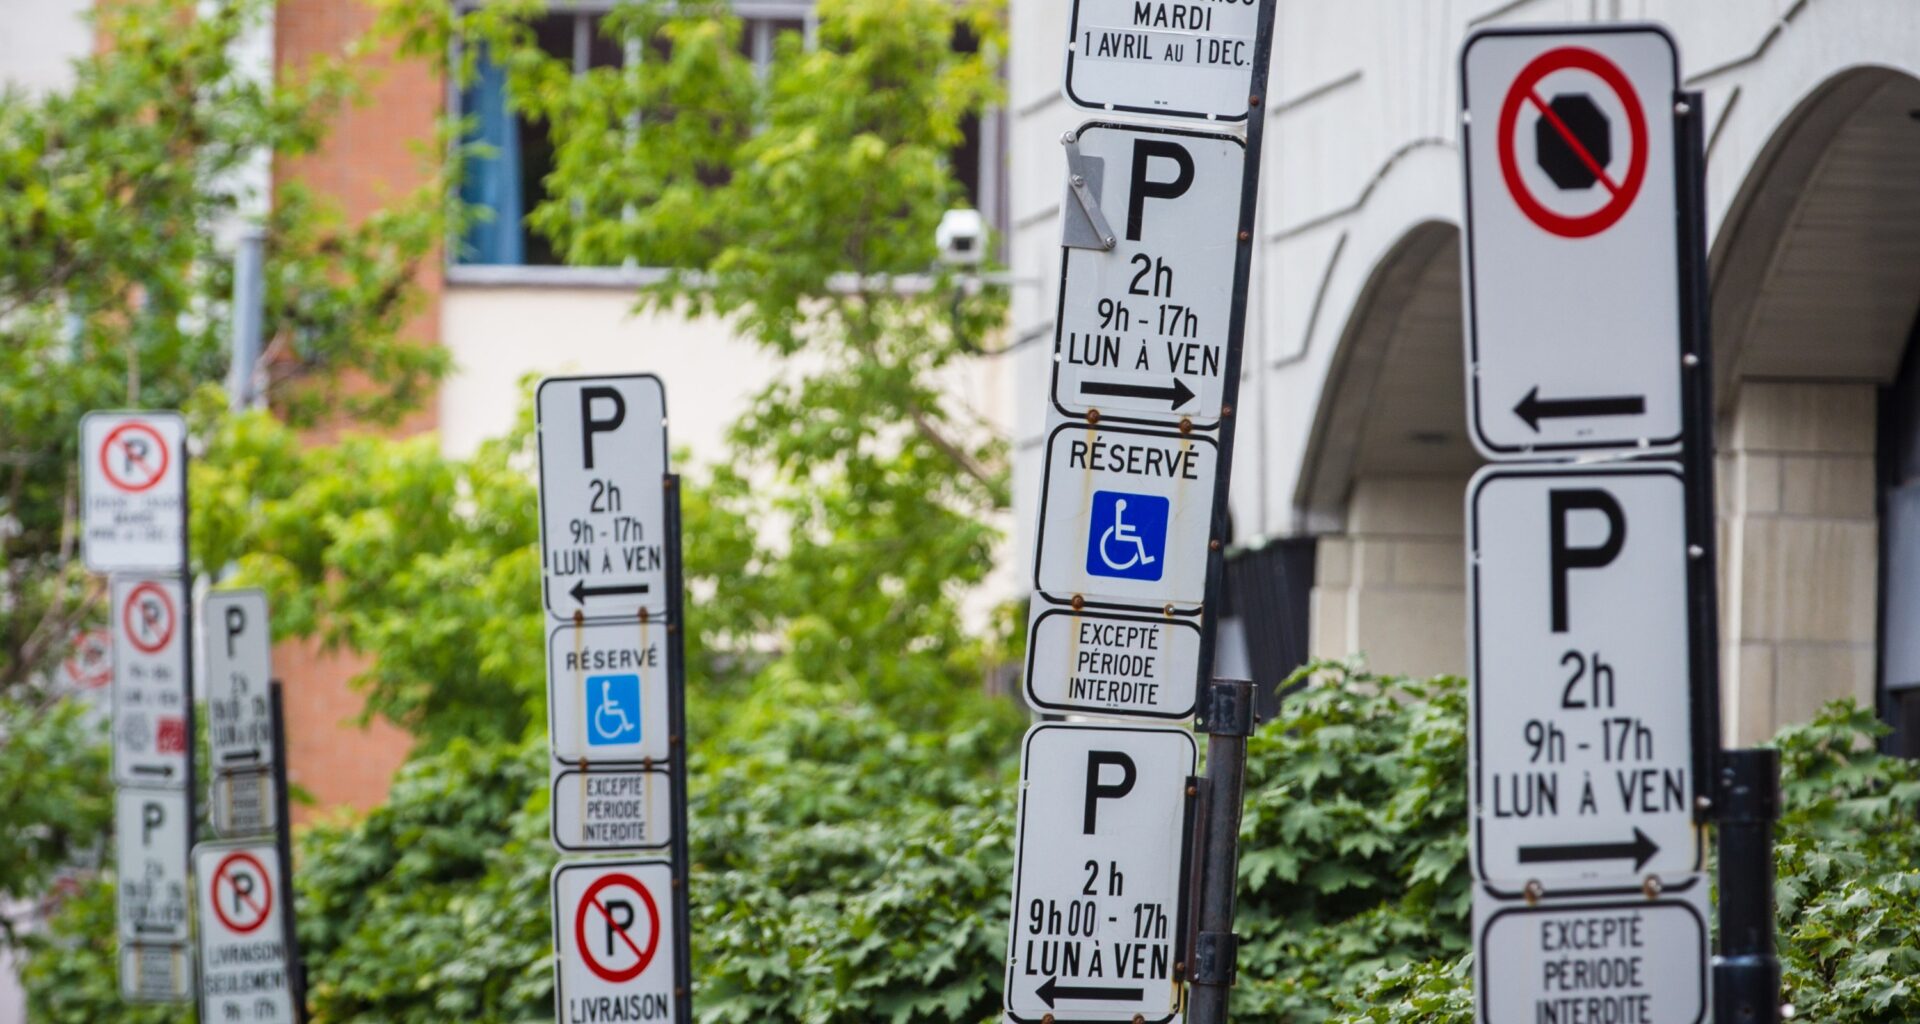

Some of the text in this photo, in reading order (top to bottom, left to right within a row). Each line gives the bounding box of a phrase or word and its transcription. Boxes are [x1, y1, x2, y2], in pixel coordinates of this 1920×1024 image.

[1134, 1, 1211, 31] MARDI
[1085, 32, 1250, 66] 1 AVRIL AU 1 DEC.
[1126, 138, 1195, 241] P
[1128, 253, 1173, 298] 2h
[1098, 298, 1129, 332] 9h
[1158, 304, 1198, 338] 17h
[1068, 333, 1220, 377] LUN À VEN
[581, 386, 626, 469] P
[1070, 436, 1199, 480] RÉSERVÉ
[590, 479, 621, 513] 2h
[570, 519, 594, 544] 9h
[614, 517, 643, 543] 17h
[553, 550, 590, 576] LUN
[623, 546, 661, 571] VEN
[1549, 488, 1627, 633] P
[225, 605, 246, 659] P
[1079, 623, 1159, 650] EXCEPTÉ
[566, 644, 657, 671] RÉSERVÉ
[1078, 649, 1155, 678] PÉRIODE
[1069, 677, 1159, 705] INTERDITE
[1560, 650, 1614, 709] 2h
[1524, 720, 1565, 763] 9h
[1602, 717, 1653, 762] 17h
[587, 774, 642, 797] EXCEPTÉ
[1083, 750, 1137, 835] P
[1494, 768, 1685, 818] LUN À VEN
[142, 802, 164, 845] P
[587, 798, 641, 819] PÉRIODE
[582, 821, 645, 841] INTERDITE
[1133, 903, 1168, 939] 17h
[1541, 910, 1643, 951] EXCEPTÉ
[1025, 940, 1169, 979] LUN À VEN
[1544, 955, 1643, 991] PÉRIODE
[570, 992, 668, 1024] LIVRAISON
[1536, 994, 1652, 1024] INTERDITE
